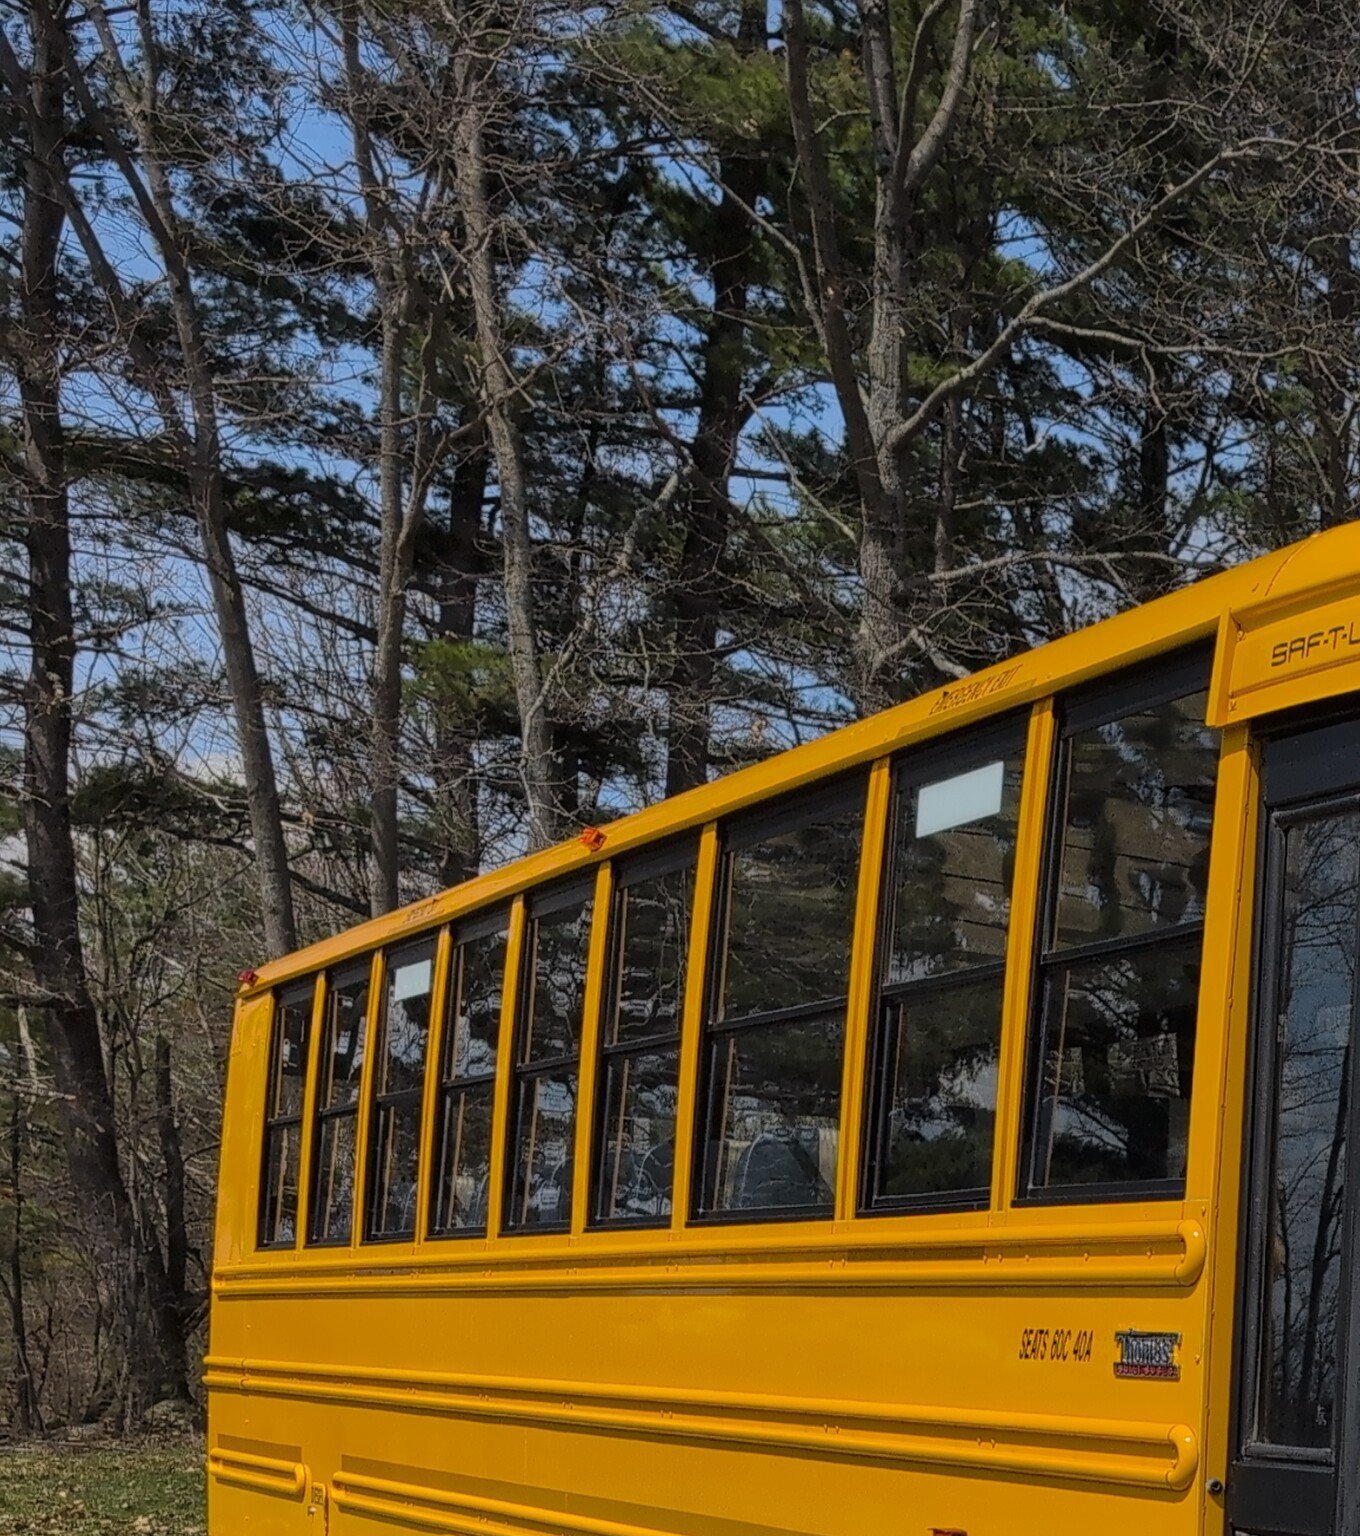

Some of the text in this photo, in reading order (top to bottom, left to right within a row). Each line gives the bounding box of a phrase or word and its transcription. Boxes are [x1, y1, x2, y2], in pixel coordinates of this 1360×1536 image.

[1019, 1327, 1094, 1362] SEATS 60C 40A
